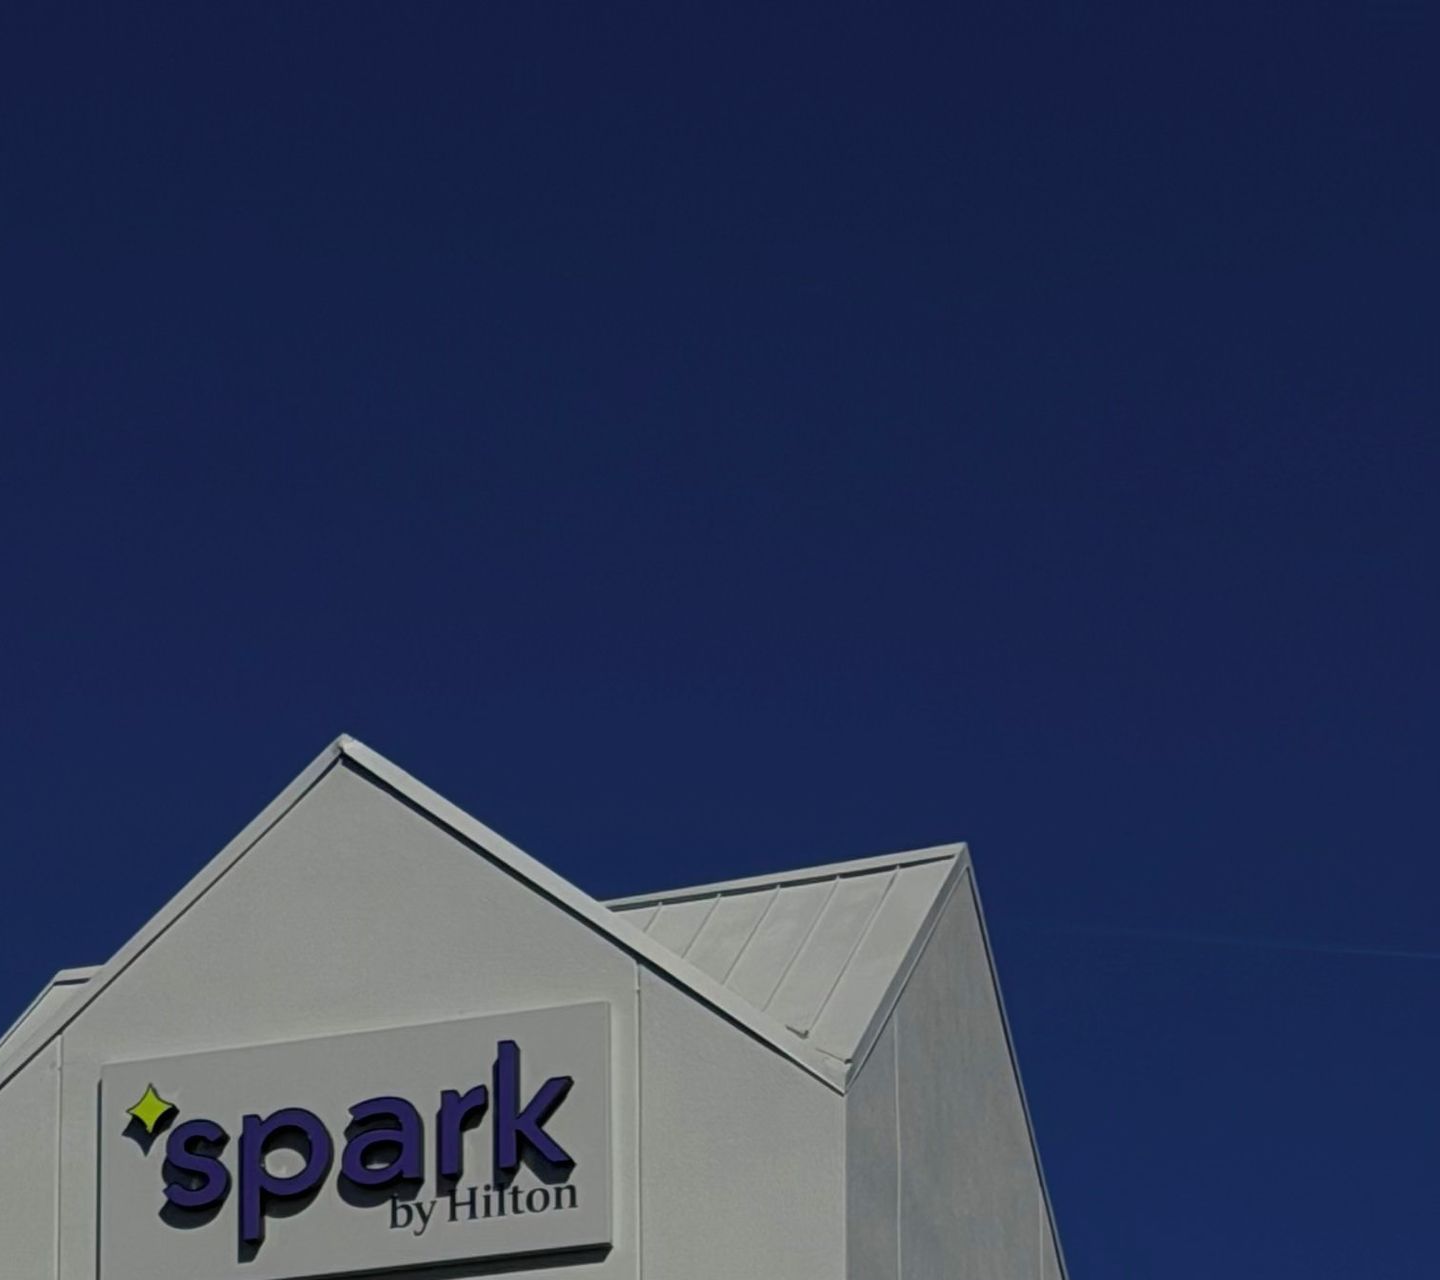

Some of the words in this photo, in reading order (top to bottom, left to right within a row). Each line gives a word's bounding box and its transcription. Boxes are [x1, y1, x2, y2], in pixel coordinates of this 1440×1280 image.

[163, 1040, 575, 1245] spark
[389, 1193, 437, 1236] by
[447, 1183, 578, 1223] Hilton
